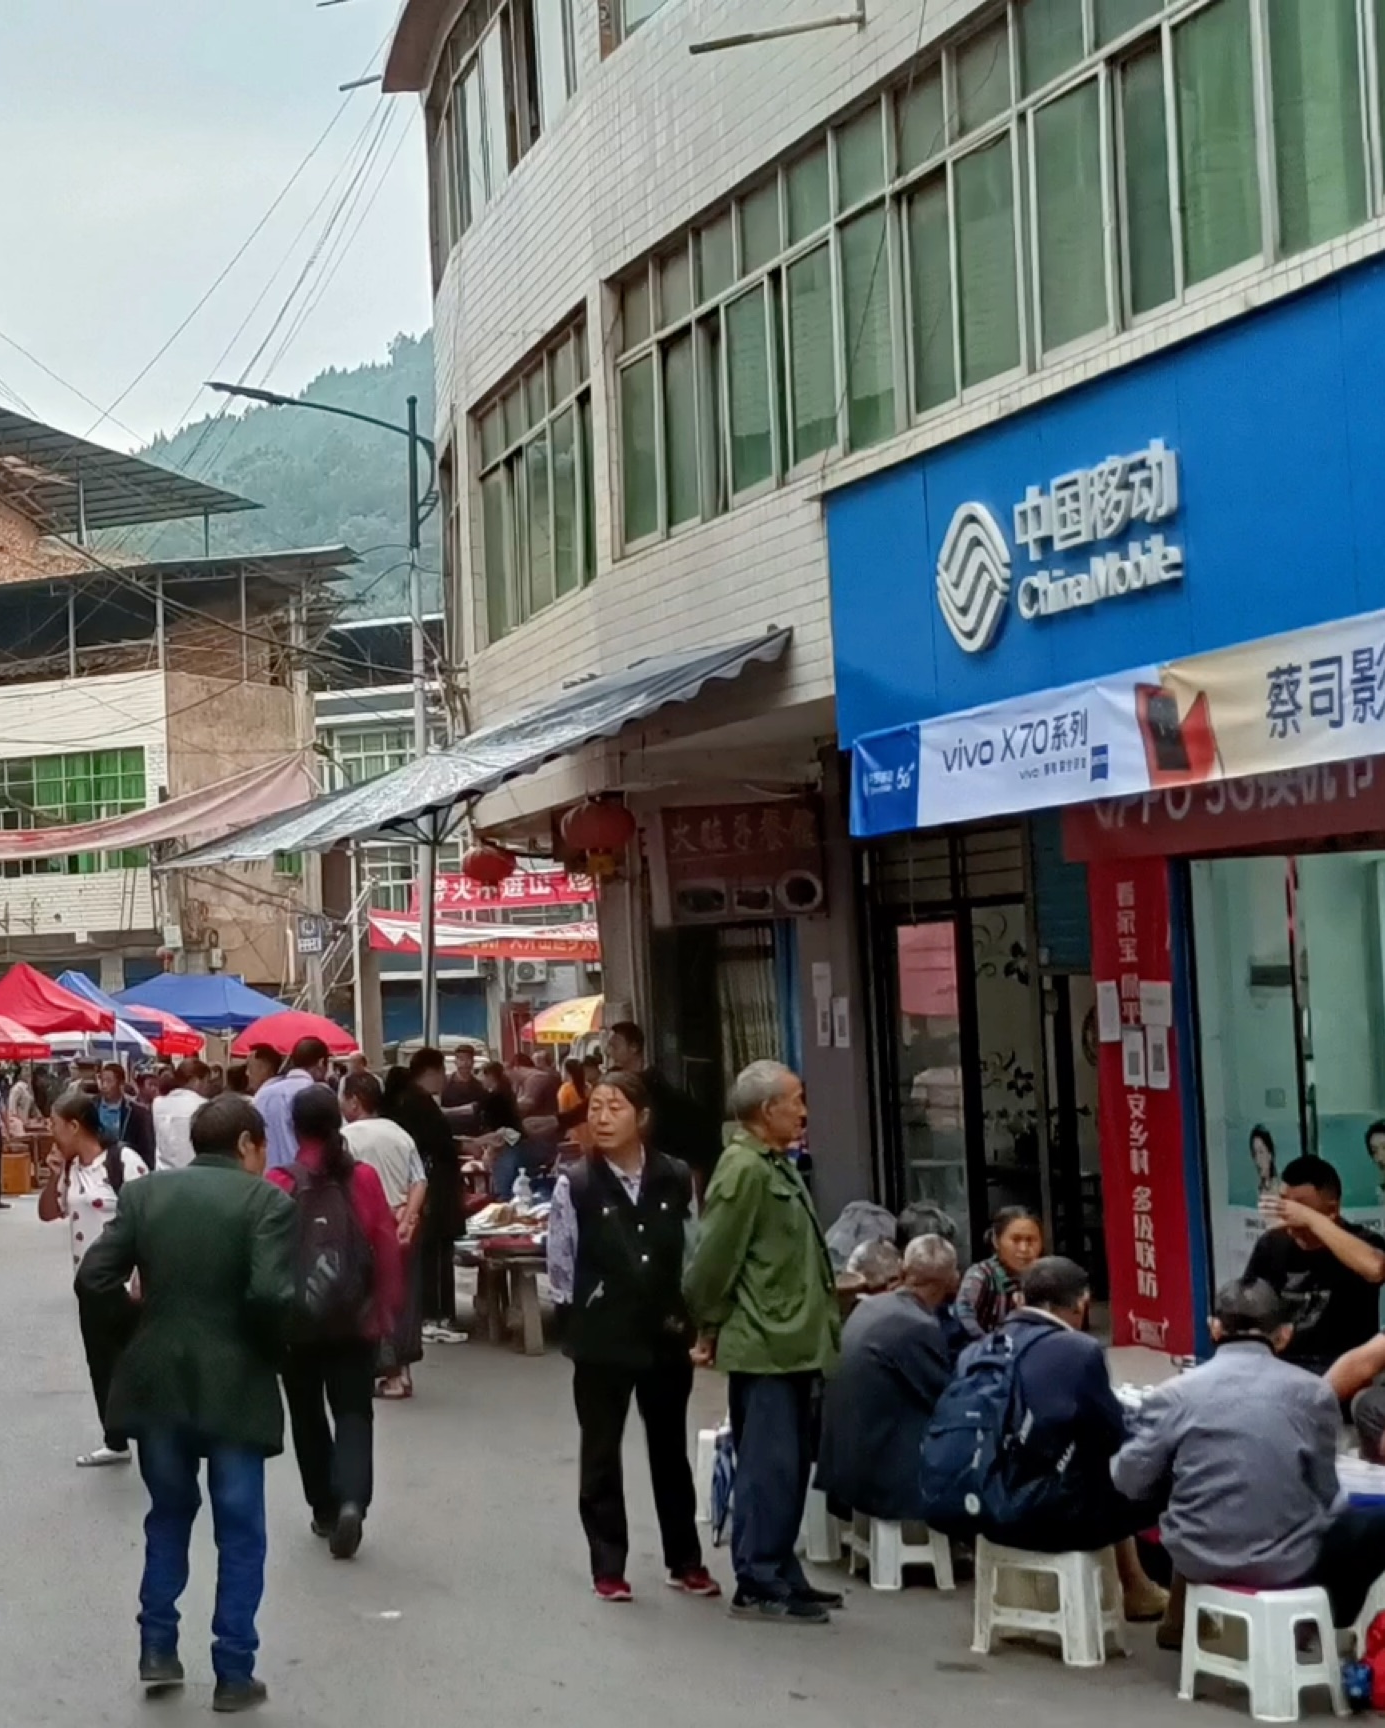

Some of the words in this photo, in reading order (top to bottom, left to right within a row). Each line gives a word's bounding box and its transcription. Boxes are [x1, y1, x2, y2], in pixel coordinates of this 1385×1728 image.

[1013, 437, 1180, 562] 中国移动
[1266, 643, 1385, 739] 蔡司影
[942, 738, 994, 773] vivo
[1000, 708, 1089, 762] X70系列
